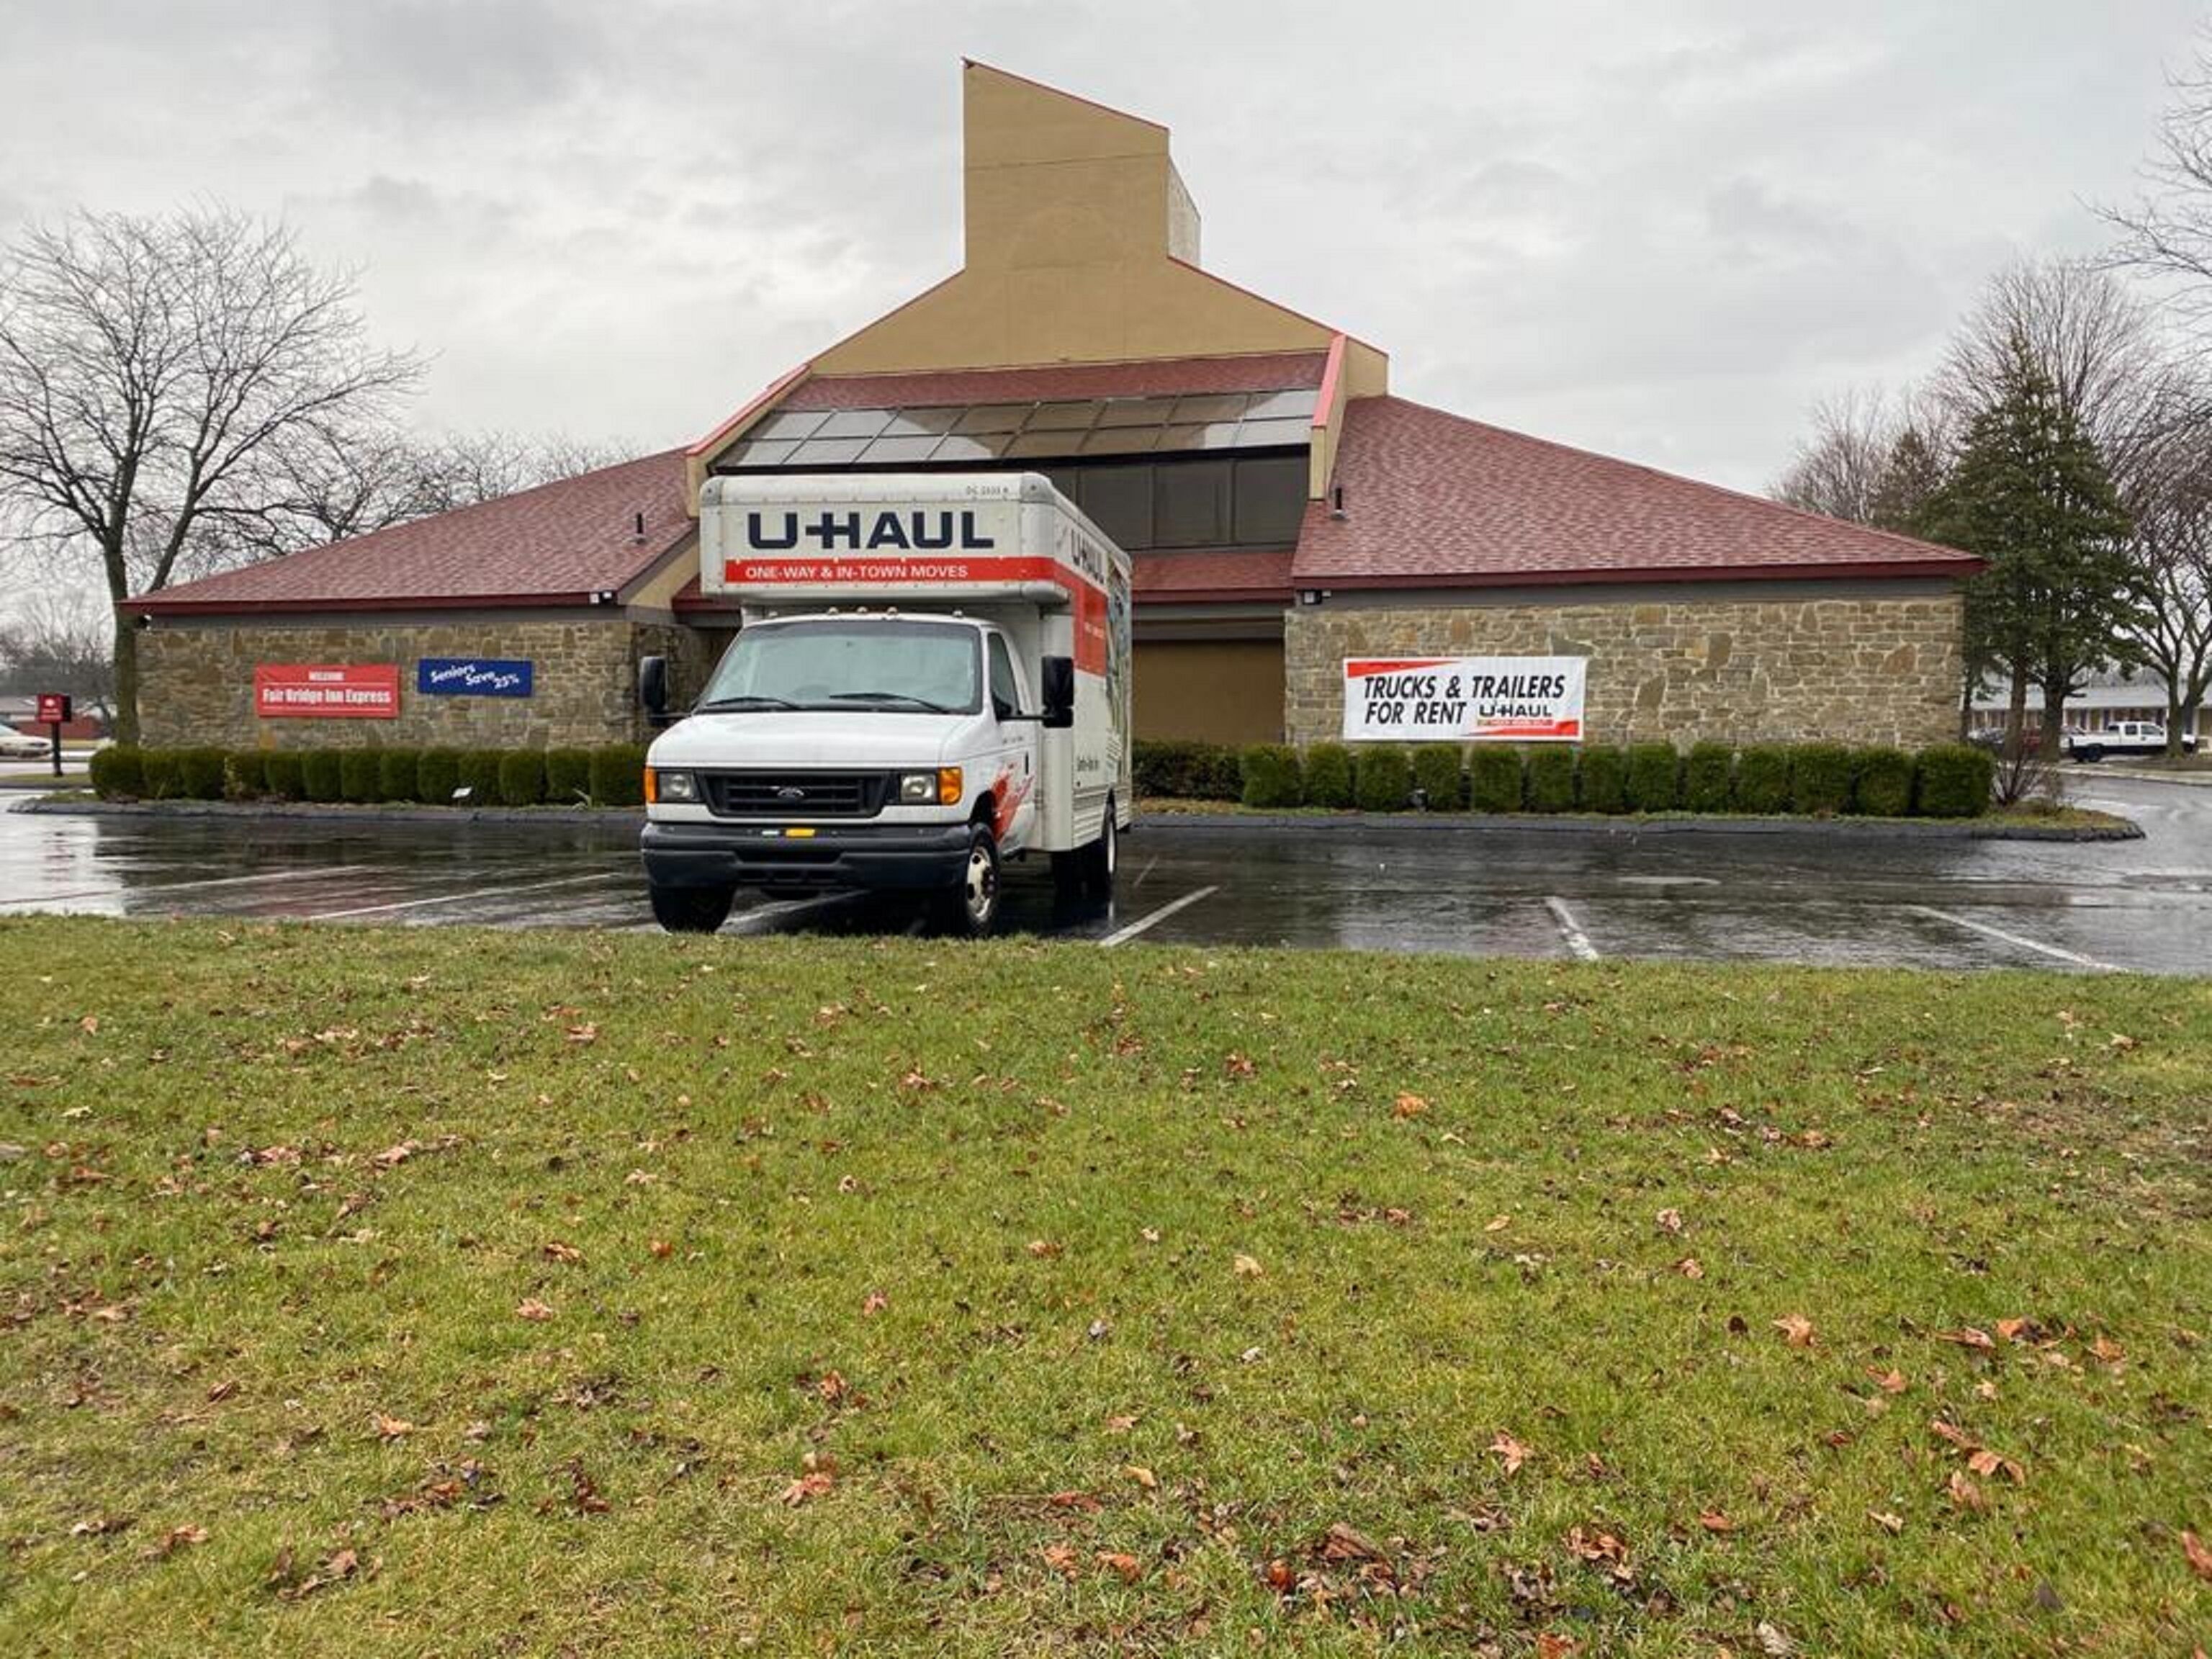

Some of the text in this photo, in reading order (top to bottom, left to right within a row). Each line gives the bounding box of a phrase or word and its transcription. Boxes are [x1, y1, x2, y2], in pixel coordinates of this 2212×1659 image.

[748, 511, 994, 549] U-HAUL
[745, 564, 968, 579] ONE-WAY & IN-TOWN MOVES
[431, 664, 475, 683] Seniors
[466, 671, 495, 686] Save
[494, 674, 520, 690] 25%
[1364, 675, 1565, 698] TRUCKS & TRAILERS
[263, 688, 392, 704] Fair Bridge Inn Express
[1364, 701, 1467, 724] FOR RENT
[1479, 704, 1552, 717] U-HAUL
